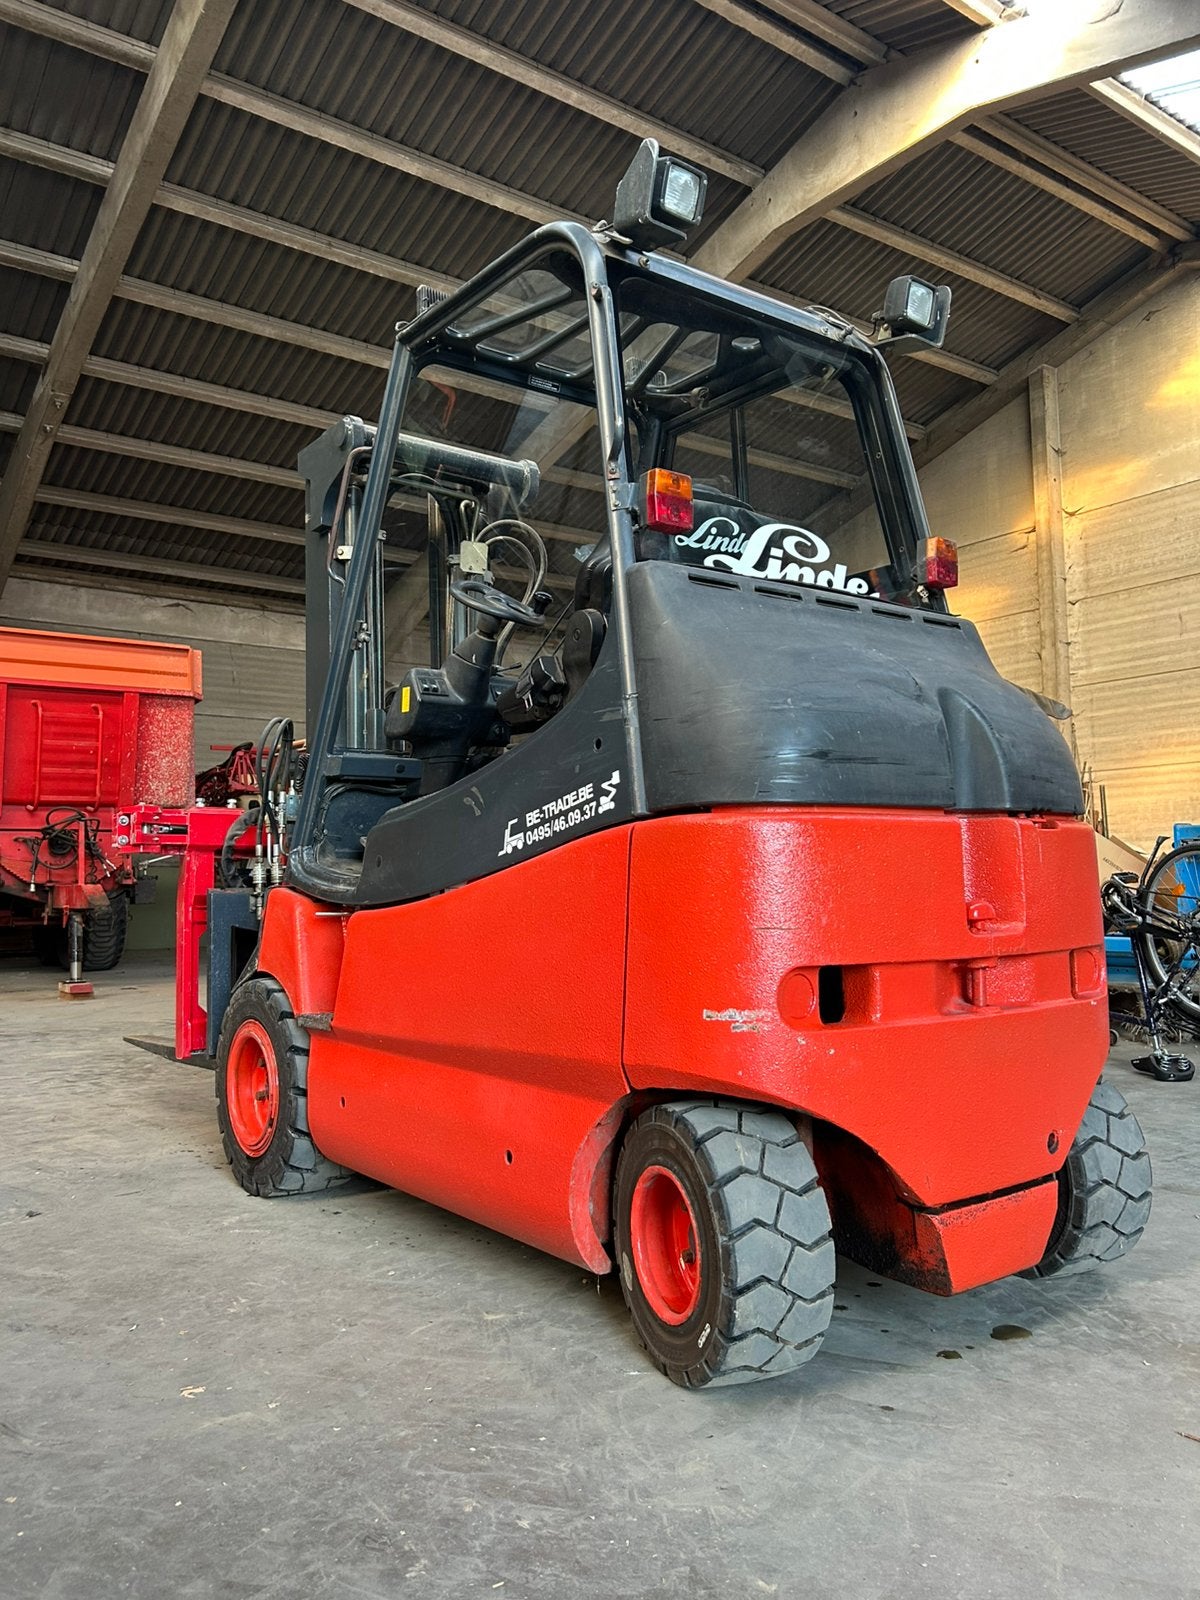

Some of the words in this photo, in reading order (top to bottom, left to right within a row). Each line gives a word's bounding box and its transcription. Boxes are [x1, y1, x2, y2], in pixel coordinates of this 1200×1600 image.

[703, 523, 880, 598] Linde
[526, 783, 594, 827] BE-TRADE.BE
[526, 801, 597, 845] 0495/46.09.37
